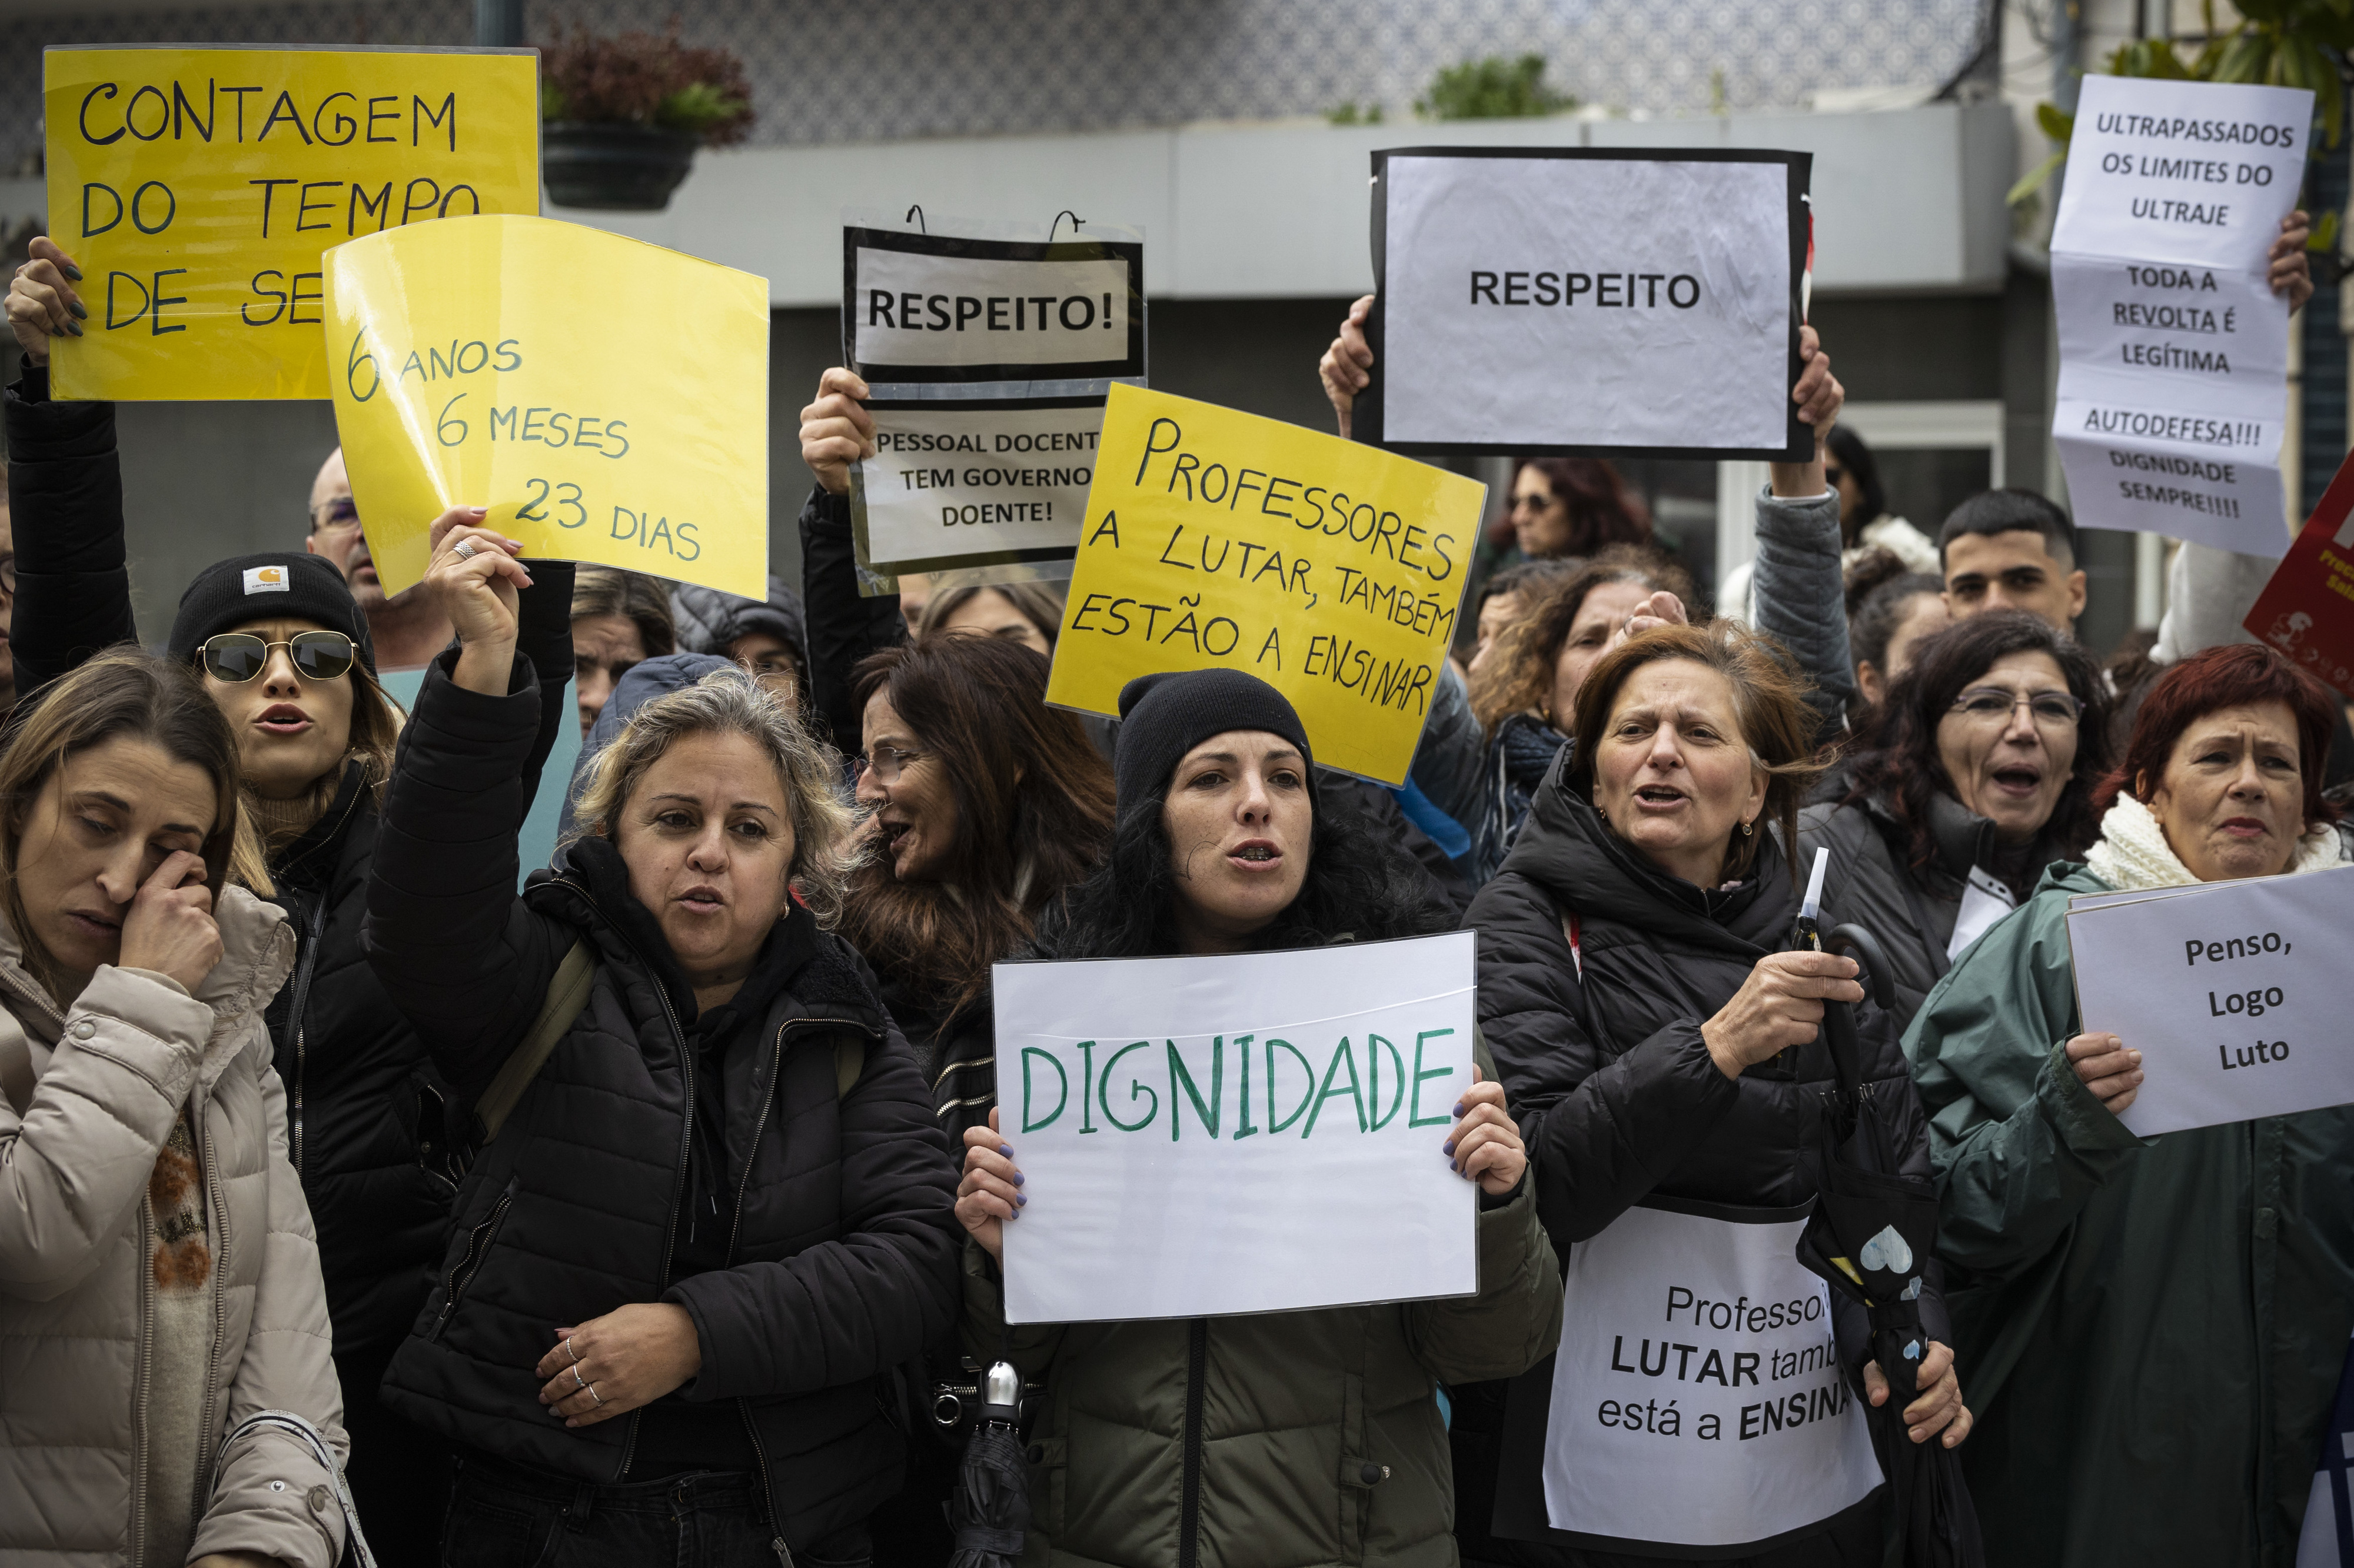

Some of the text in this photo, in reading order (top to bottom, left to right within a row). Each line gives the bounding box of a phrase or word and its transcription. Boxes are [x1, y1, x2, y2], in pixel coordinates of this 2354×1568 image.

[79, 78, 456, 152] CONTAGEM
[2097, 113, 2294, 148] ULTRAPASSADOS
[2102, 153, 2273, 187] OS LIMITES DO
[82, 180, 176, 238] DO
[2132, 198, 2230, 227] ULTRAJE
[1470, 271, 1701, 309] RESPEITO
[2126, 266, 2218, 292] TODA A
[106, 268, 323, 337] DE SE
[869, 288, 1112, 332] RESPEITO!
[2113, 302, 2236, 332] REVOLTA É
[347, 325, 523, 402] 6 ANOS
[2122, 341, 2230, 374] LEGÍTIMA
[437, 392, 630, 459] 6 MESES
[877, 431, 1099, 454] PESSOAL DOCENT
[2083, 408, 2262, 447] AUTODEFESA!!!
[899, 467, 1092, 491] TEM GOVERNO
[2109, 450, 2237, 484] DIGNIDADE
[942, 501, 1053, 527] DOENTE!
[1136, 418, 1455, 581] PROFESSORES
[2119, 480, 2240, 520] SEMPRE!!!!
[515, 478, 701, 562] 23 DIAS
[1089, 510, 1455, 644] A LUTAR, TAMBÉM
[1072, 592, 1432, 716] ESTÃO A ENSINAR
[2185, 931, 2292, 967] Penso,
[2208, 986, 2285, 1017] Logo
[2219, 1040, 2290, 1070] Luto
[1021, 1028, 1455, 1142] DIGNIDADE
[1611, 1333, 1836, 1388] LUTAR tamb
[1597, 1398, 1681, 1437] está
[1696, 1412, 1721, 1441] a
